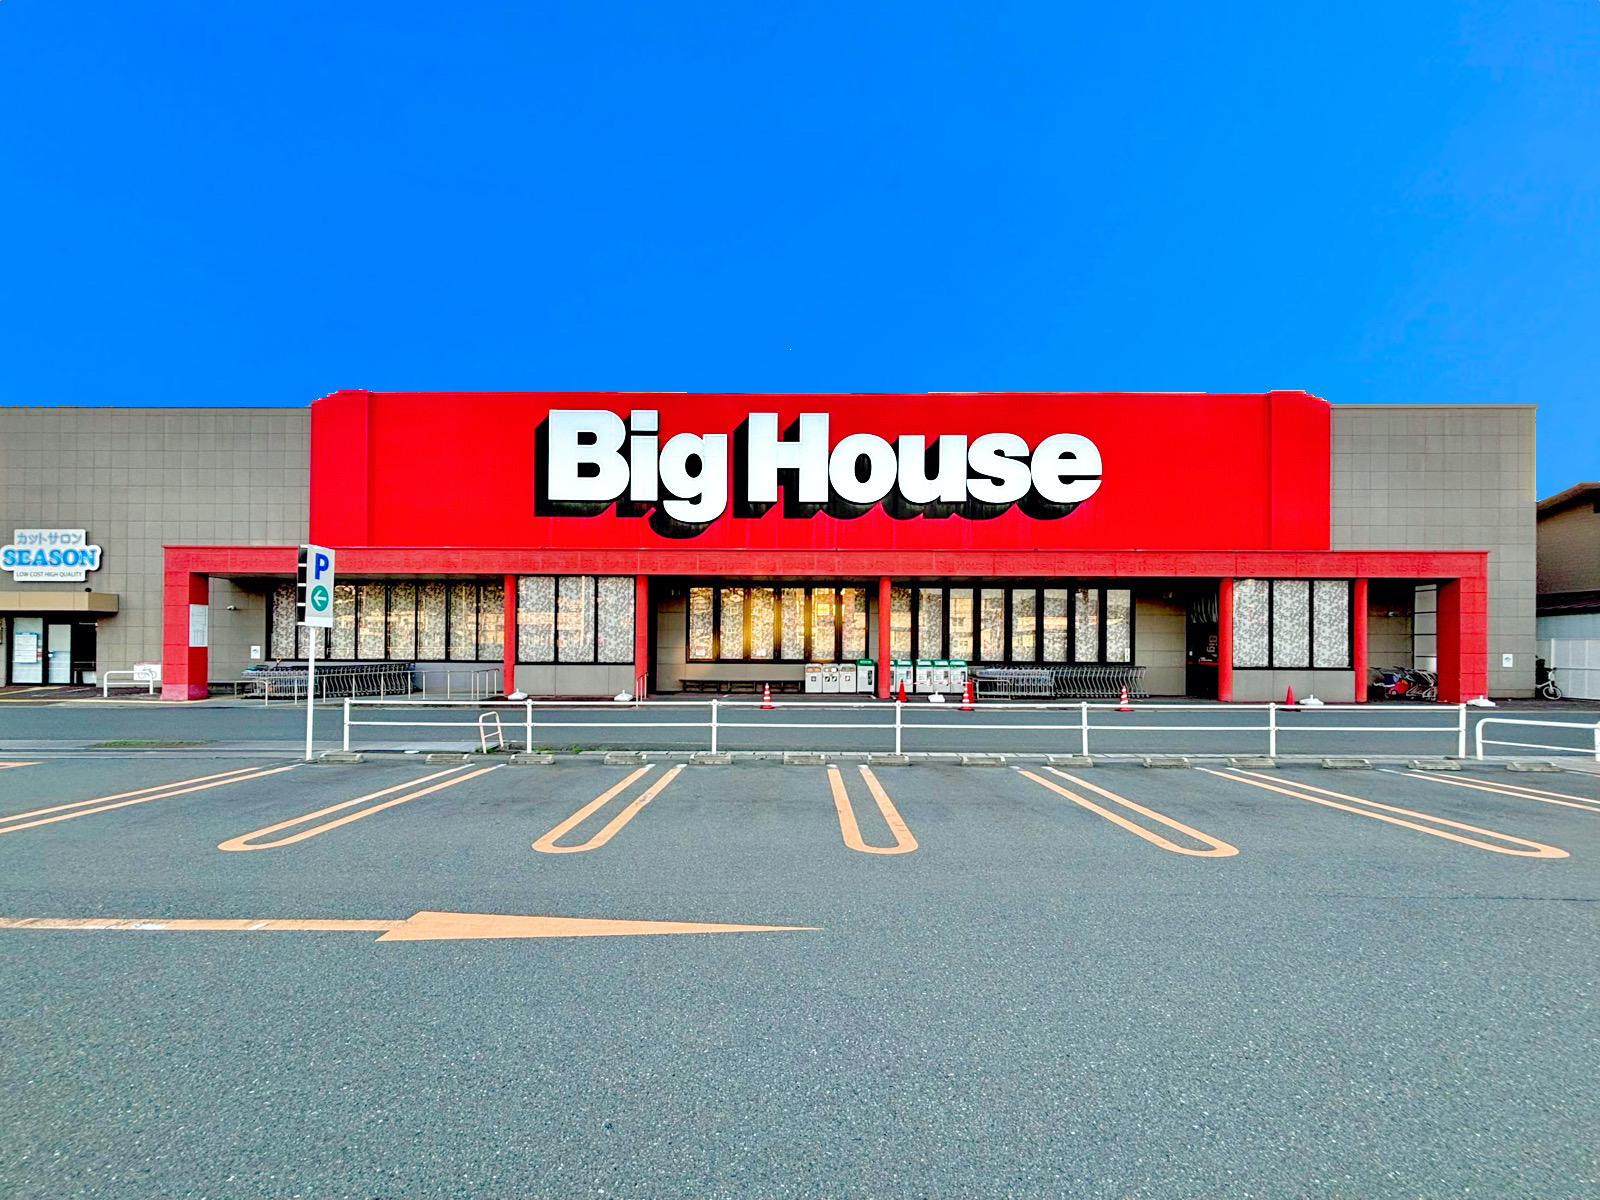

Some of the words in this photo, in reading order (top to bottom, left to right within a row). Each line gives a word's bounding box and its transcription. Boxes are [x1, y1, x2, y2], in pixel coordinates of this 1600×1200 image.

[548, 410, 727, 522] Big
[748, 412, 1103, 504] House
[17, 532, 82, 544] カットサロン
[3, 549, 96, 566] SEASON
[314, 553, 329, 580] P
